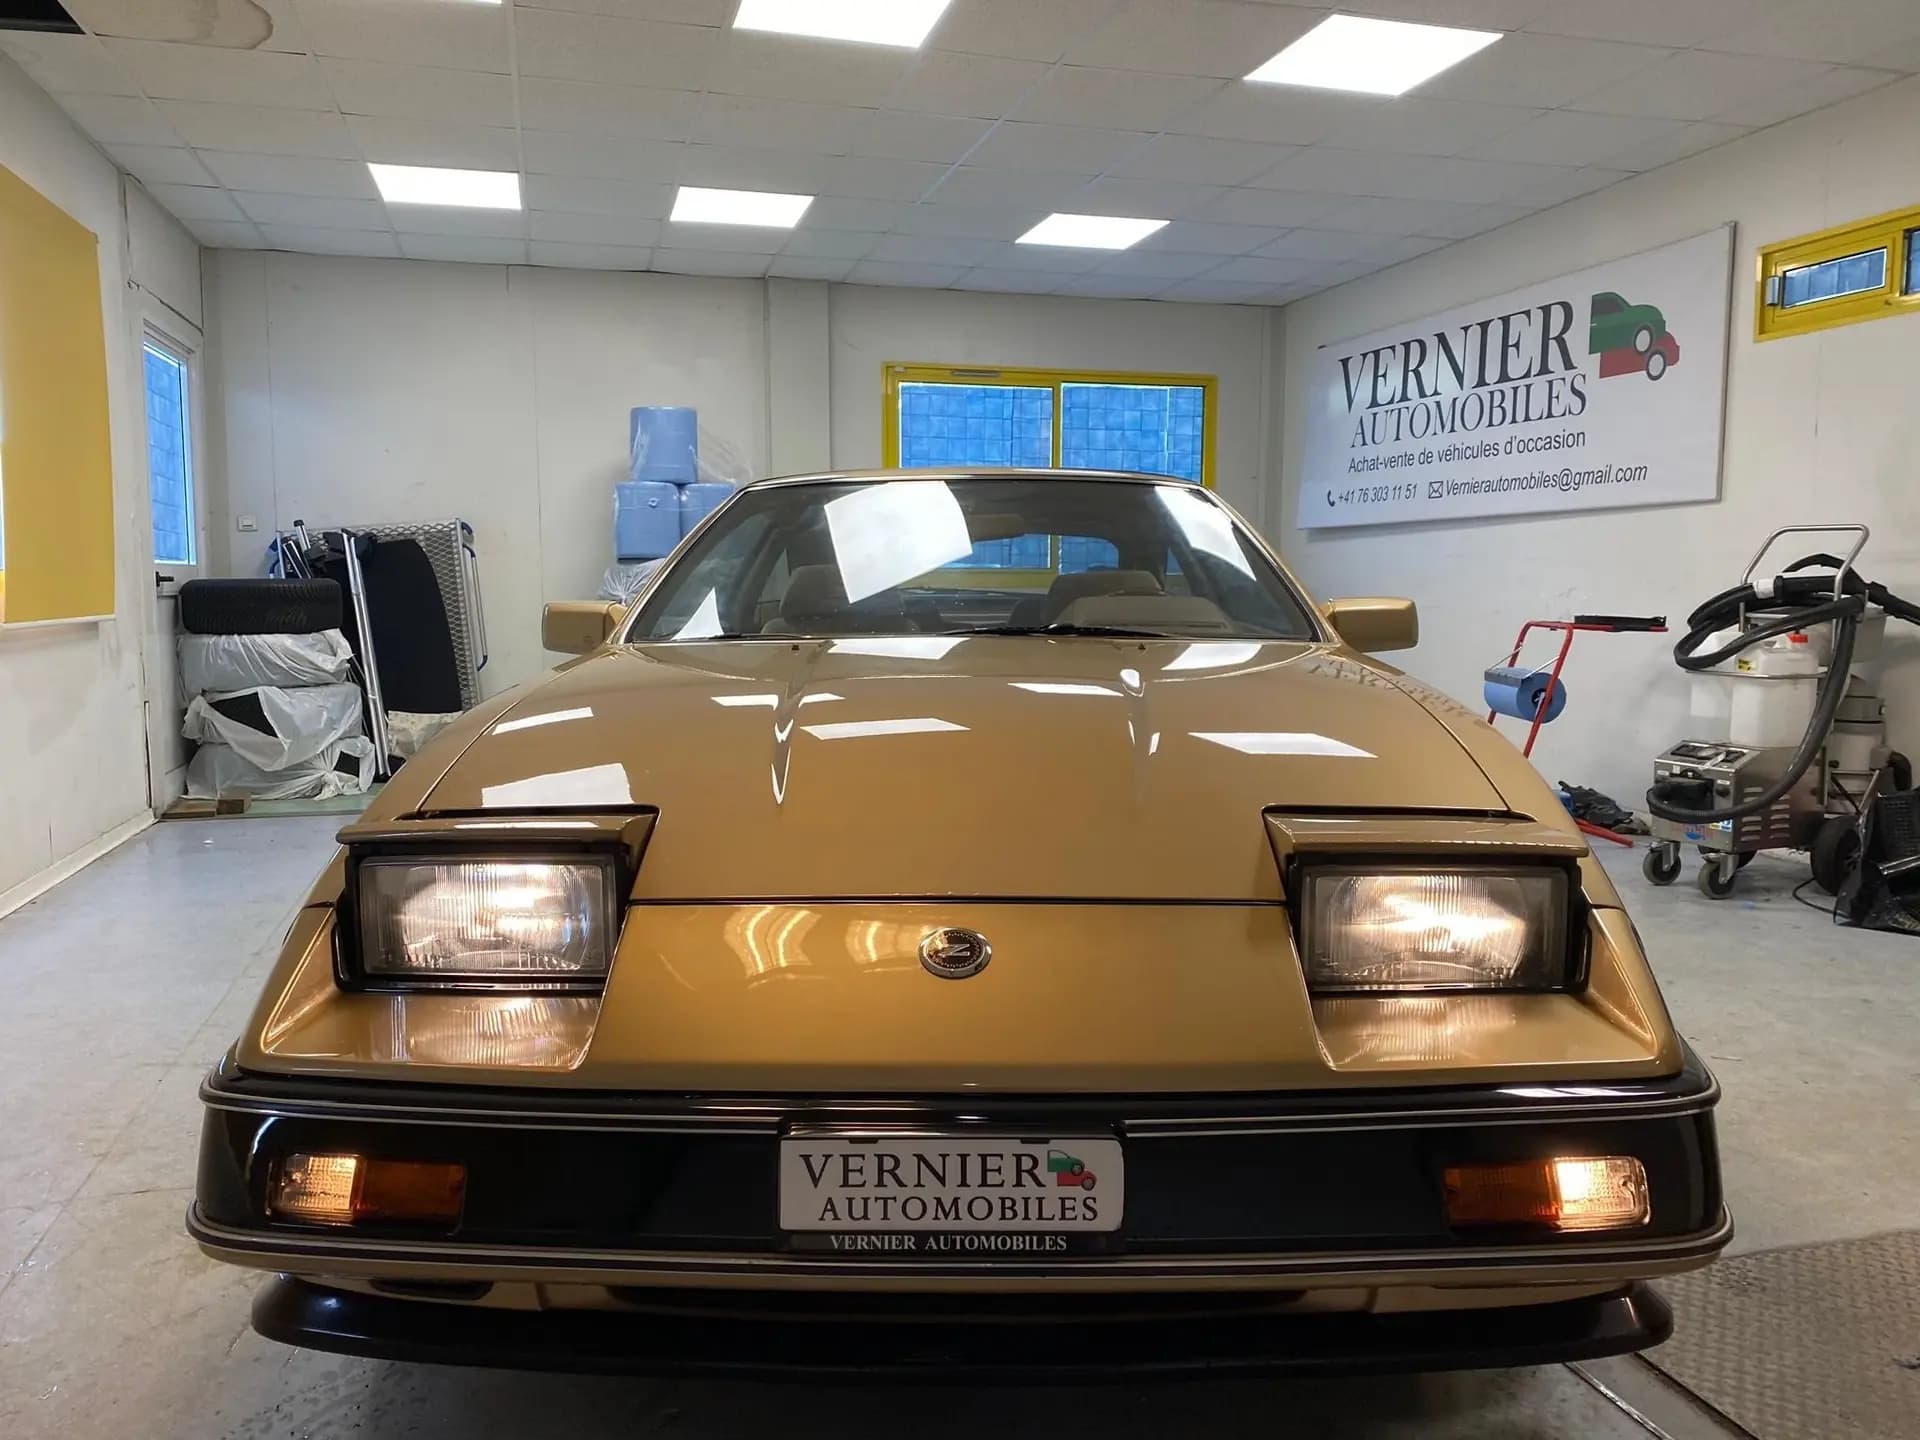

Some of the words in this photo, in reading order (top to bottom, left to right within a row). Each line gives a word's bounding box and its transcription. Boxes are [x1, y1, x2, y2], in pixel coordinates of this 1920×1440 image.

[1337, 300, 1578, 413] VERNIER
[1350, 373, 1587, 449] AUTOMOBILES
[1348, 451, 1415, 474] Achat-vente
[1418, 447, 1434, 466] de
[1438, 440, 1500, 463] véhicules
[1504, 429, 1586, 455] d'occasion
[1338, 489, 1355, 504] +41
[1357, 487, 1369, 503] 76
[1371, 485, 1389, 503] 303
[1392, 484, 1402, 501] 11
[1405, 482, 1417, 500] 51
[1446, 464, 1648, 497] Vernierautomobiles@gmail.com
[799, 1152, 1046, 1189] VERNIER
[818, 1196, 1098, 1222] AUTOMOBILES
[830, 1234, 916, 1250] VERNIER
[925, 1234, 1067, 1251] AUTOMOBILES
